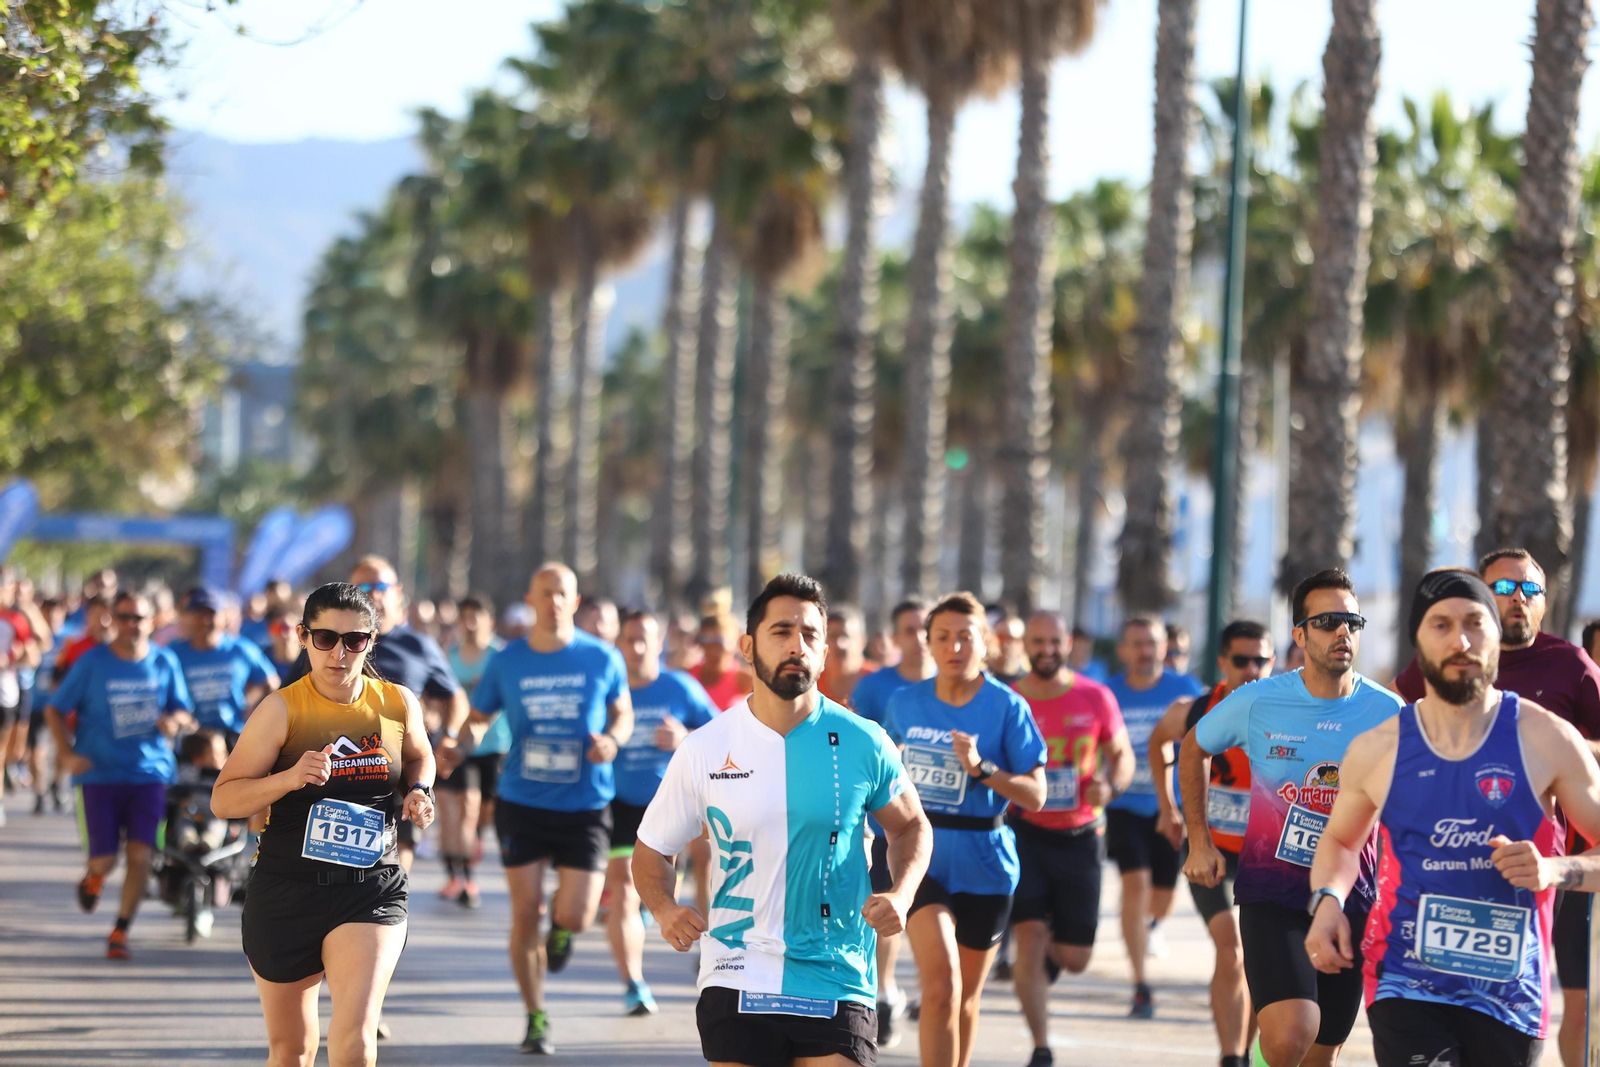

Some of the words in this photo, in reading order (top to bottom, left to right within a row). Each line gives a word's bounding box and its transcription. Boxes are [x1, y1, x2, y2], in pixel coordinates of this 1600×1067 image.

[1316, 719, 1342, 732] vive
[332, 756, 388, 769] RECAMINOS
[332, 767, 356, 777] EAM
[358, 764, 390, 774] TRAIL
[355, 773, 388, 781] running
[709, 772, 750, 780] Vulkano
[911, 766, 956, 786] 1769
[324, 811, 352, 822] Solidaria
[325, 805, 349, 815] Carrera
[1300, 815, 1324, 826] Carrera
[318, 822, 377, 848] 1917
[1294, 830, 1320, 849] 16
[1429, 818, 1494, 848] Ford
[1422, 858, 1467, 871] Garum
[1470, 857, 1496, 870] Mo
[1441, 904, 1471, 916] Carrera
[1490, 909, 1523, 919] mayoral
[1439, 911, 1476, 924] Solidaria
[1433, 926, 1512, 956] 1729
